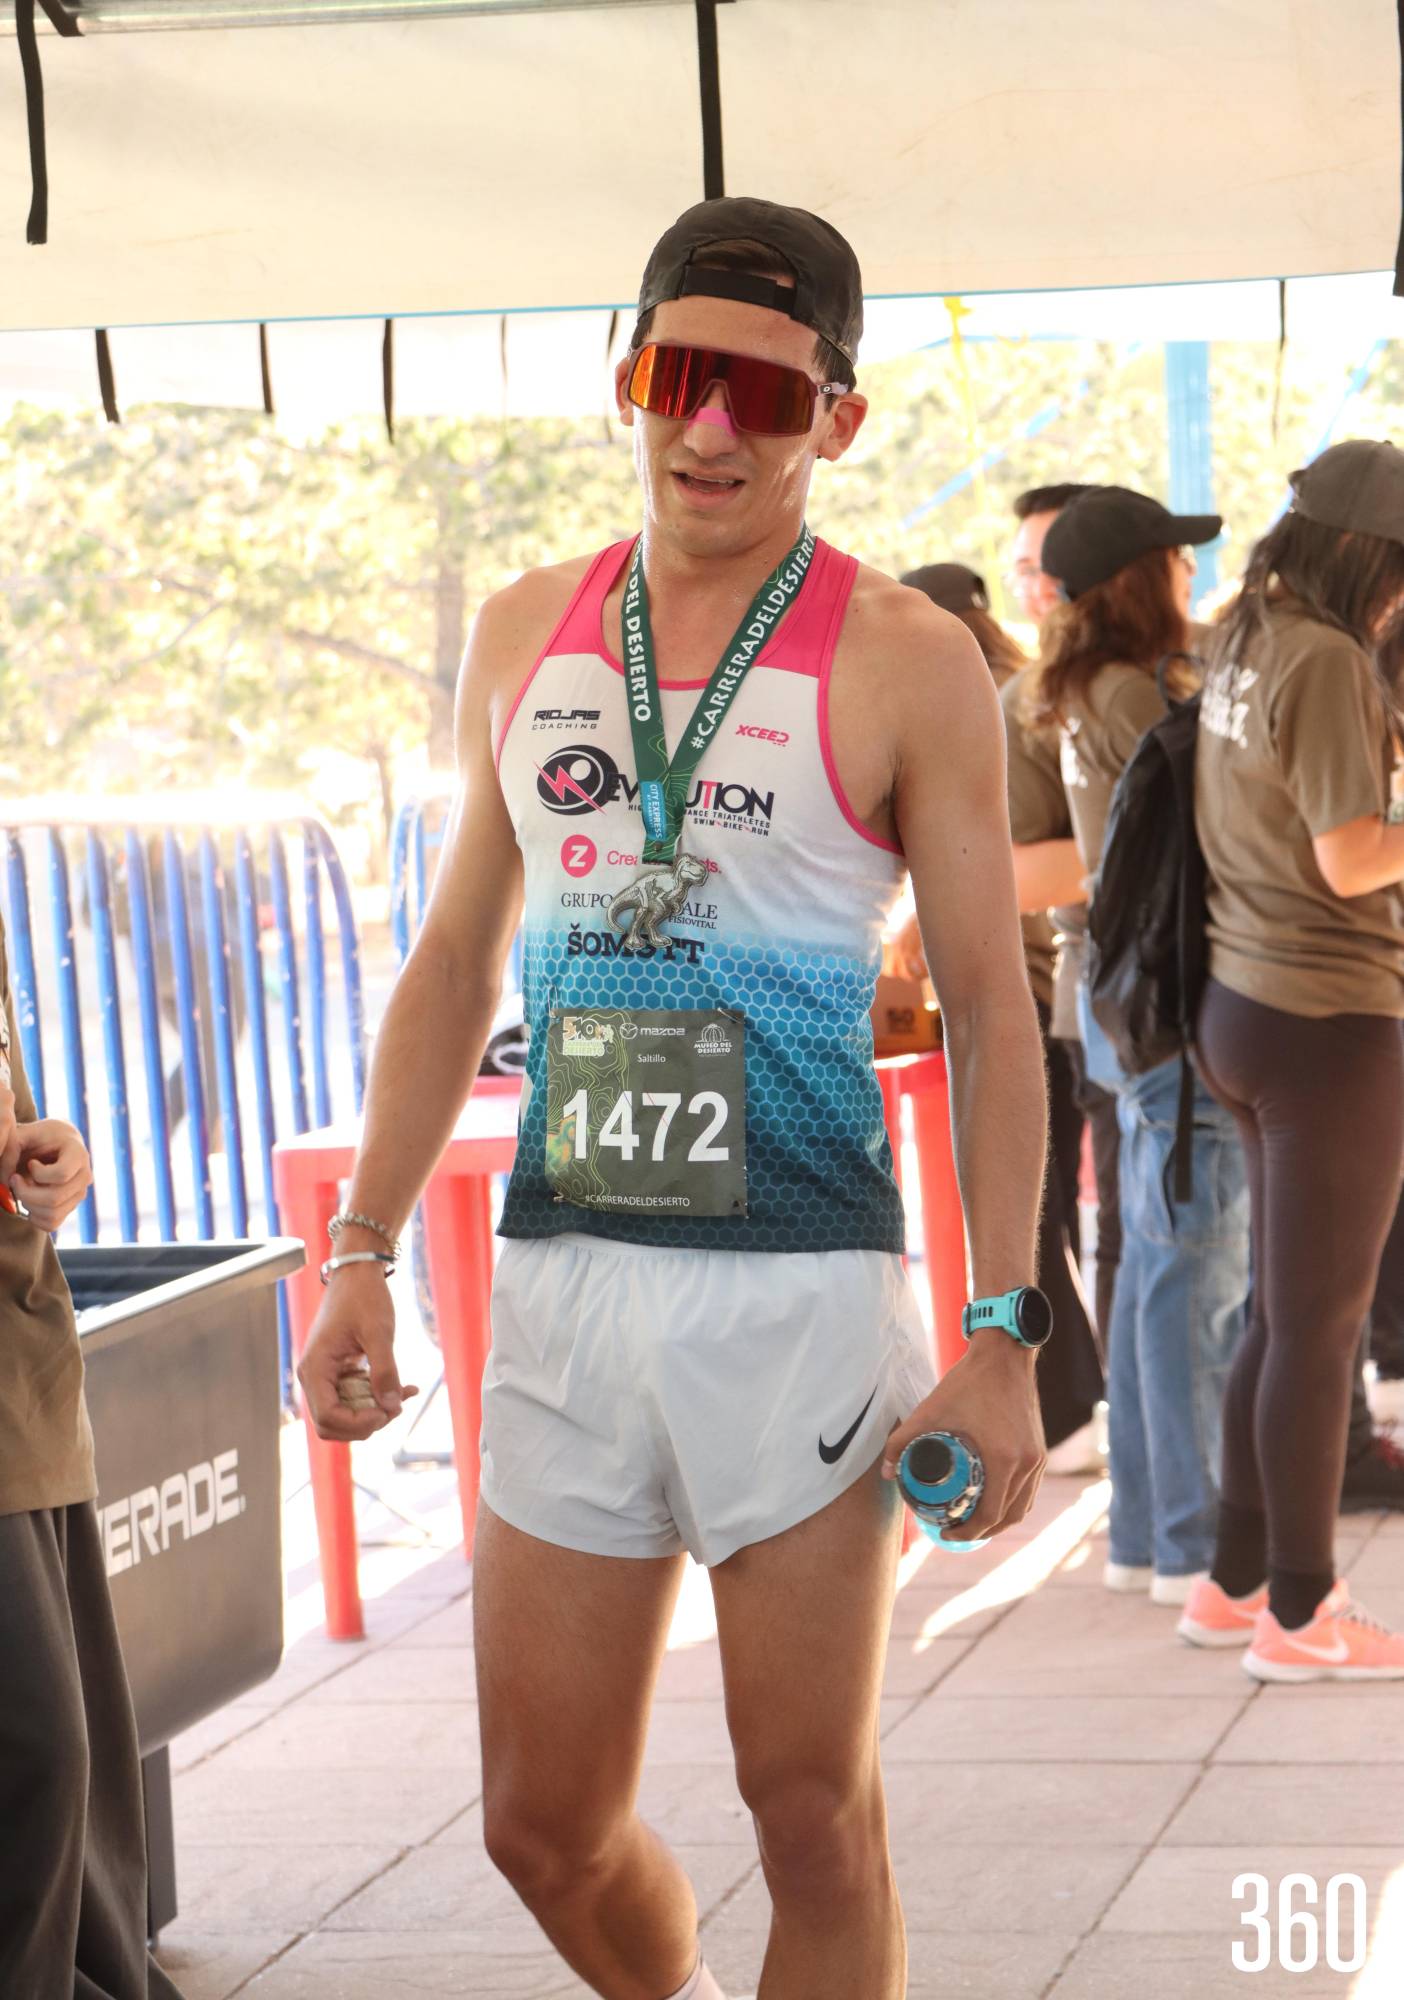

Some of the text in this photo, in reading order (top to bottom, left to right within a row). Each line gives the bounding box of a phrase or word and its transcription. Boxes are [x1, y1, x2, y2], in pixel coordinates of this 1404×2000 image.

[625, 574, 640, 614] DEL
[690, 528, 816, 749] #CARRERADELDESIERT
[626, 615, 652, 722] DESIERTO
[534, 709, 602, 721] RIOJAS
[531, 722, 598, 731] COACHING
[735, 724, 790, 744] XCEED
[607, 772, 775, 821] EVUTION
[649, 784, 660, 801] CITY
[651, 801, 663, 839] EXPRESS
[693, 818, 770, 837] SWIM BIKE RUN
[712, 811, 771, 829] TRIATHLETES
[561, 892, 614, 909] GRUPO
[637, 1054, 667, 1063] Saltillo
[562, 1089, 730, 1162] 1472
[584, 1194, 691, 1208] #CARRERADELDESIERTO
[97, 1447, 241, 1578] ERADE
